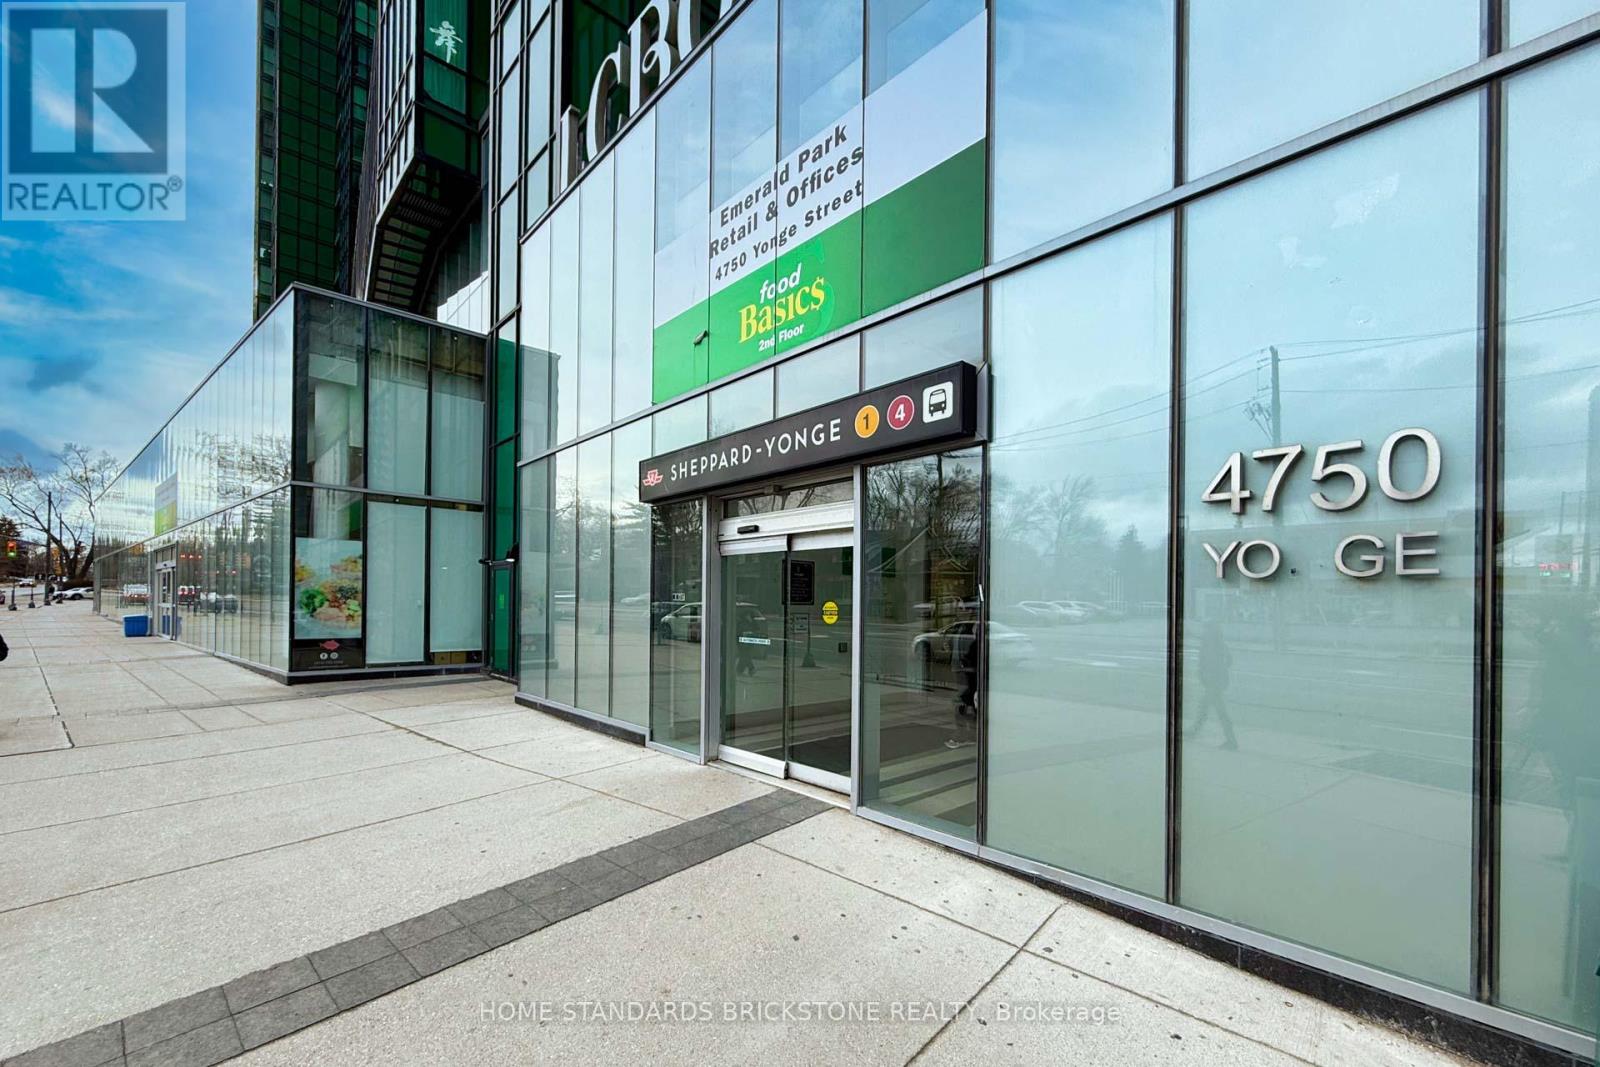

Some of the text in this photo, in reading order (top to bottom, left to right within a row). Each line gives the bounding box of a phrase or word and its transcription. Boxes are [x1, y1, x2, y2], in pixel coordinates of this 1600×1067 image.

[709, 146, 864, 259] Retail & Offices
[720, 125, 847, 227] Emerald Park
[715, 179, 863, 281] 4750 Yonge Street
[759, 262, 802, 304] food
[758, 323, 804, 352] 2nd Floor
[670, 418, 841, 482] SHEPPARD-YONGE
[894, 404, 905, 422] 4
[1201, 427, 1442, 515] 4750
